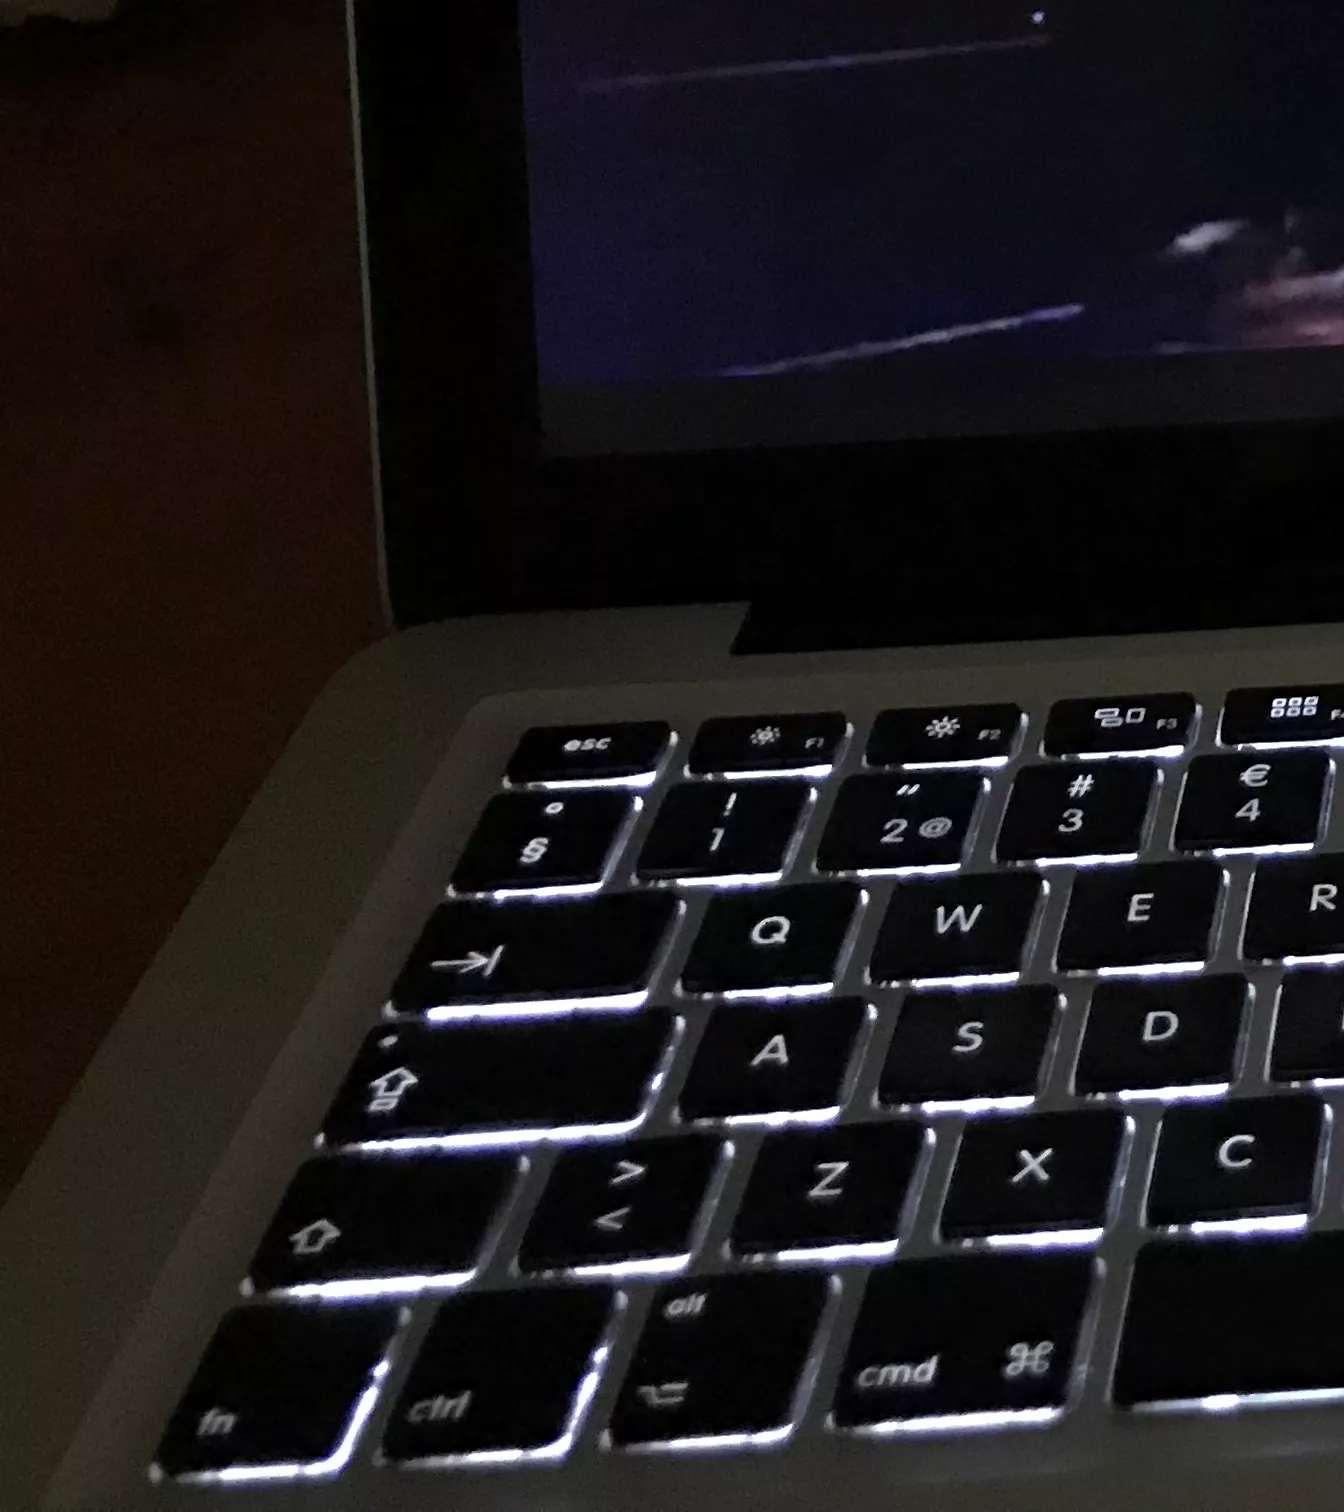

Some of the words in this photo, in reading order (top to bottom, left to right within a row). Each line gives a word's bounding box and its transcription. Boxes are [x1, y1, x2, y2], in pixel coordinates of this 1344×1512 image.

[977, 728, 1001, 741] F2
[1156, 718, 1178, 730] F3
[563, 737, 612, 753] esc
[804, 737, 825, 749] F1
[1067, 773, 1095, 798] #
[1239, 763, 1272, 788] €
[1057, 808, 1084, 833] 3
[1234, 797, 1261, 822] 4
[709, 827, 725, 852] 1
[1126, 892, 1155, 923] E
[1309, 883, 1338, 912] R
[749, 915, 791, 945] Q
[936, 903, 983, 935] W
[952, 1021, 985, 1053] S
[1142, 1010, 1179, 1043] D
[750, 1033, 789, 1067] A
[1010, 1147, 1054, 1184] X
[1217, 1134, 1256, 1169] C
[807, 1160, 850, 1199] Z
[664, 1293, 707, 1318] alt
[857, 1354, 939, 1388] cmd
[410, 1390, 471, 1421] ctrl
[198, 1408, 236, 1435] fn
